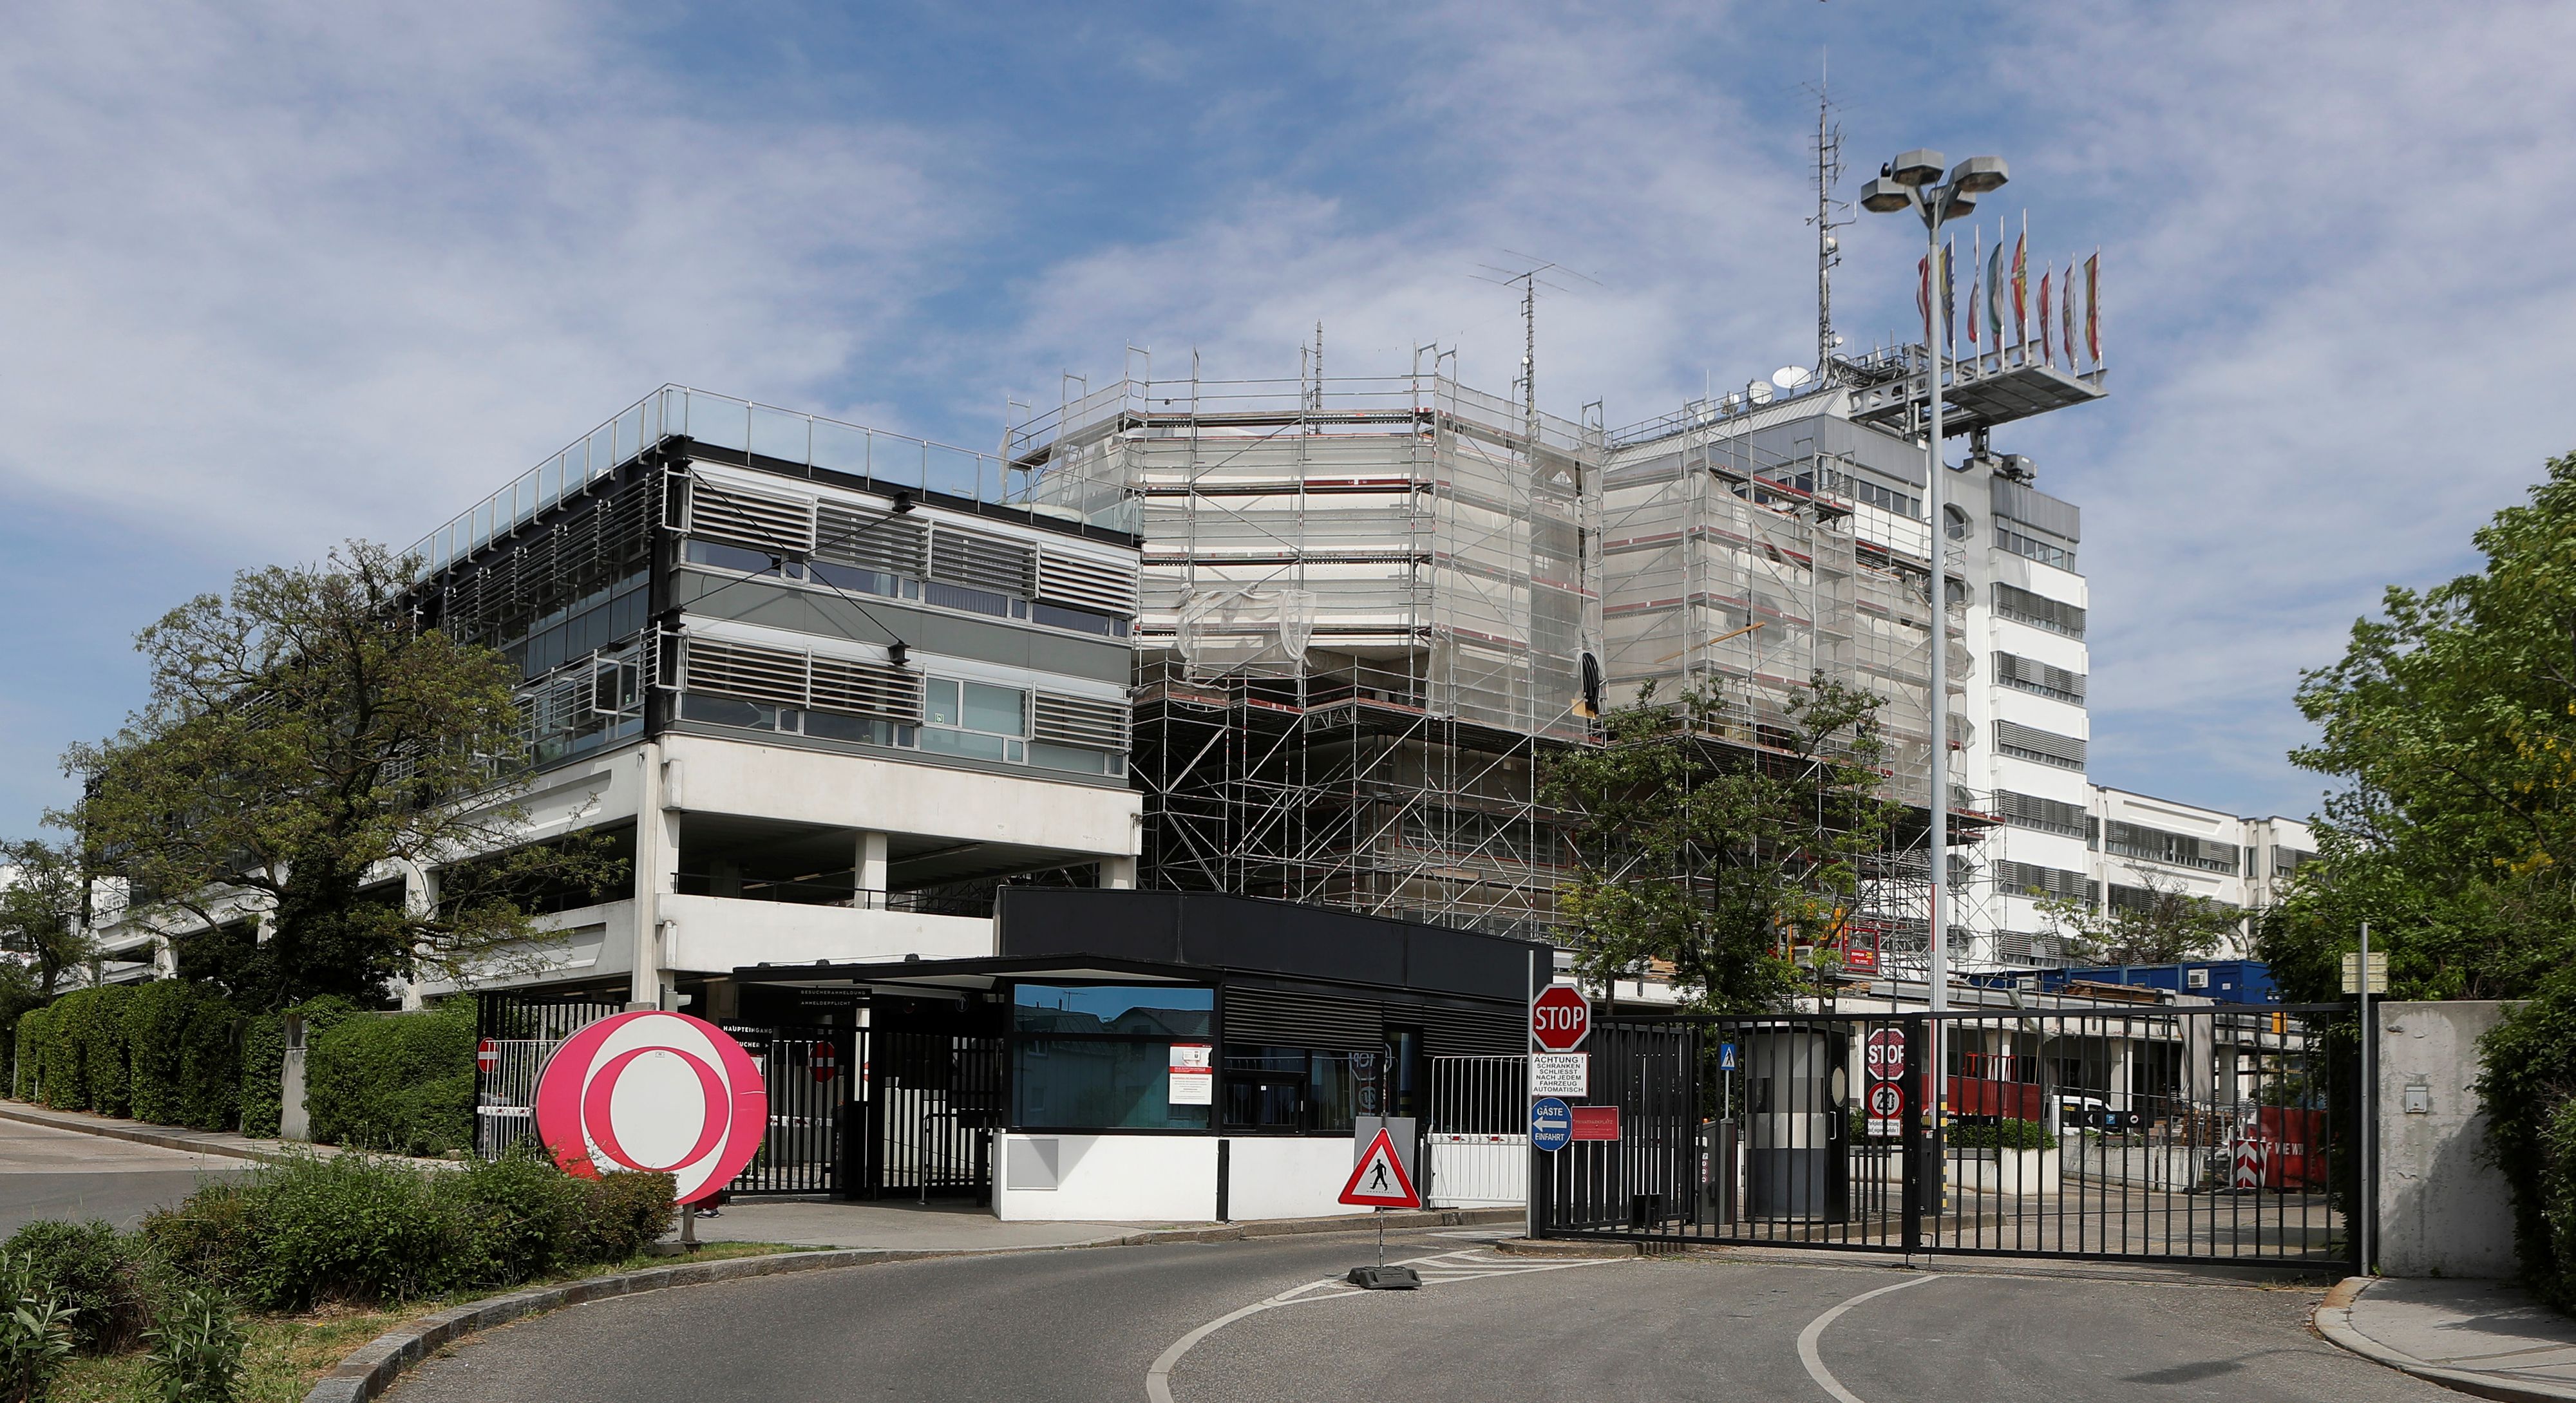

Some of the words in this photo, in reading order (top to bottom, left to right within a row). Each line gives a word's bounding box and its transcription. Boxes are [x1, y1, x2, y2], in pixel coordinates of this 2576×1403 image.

[1536, 1006, 1584, 1030] STOP
[723, 1025, 773, 1034] HAUPTEINGANG
[1537, 1105, 1564, 1116] GÄSTE
[1535, 1133, 1565, 1142] EINFAHRT
